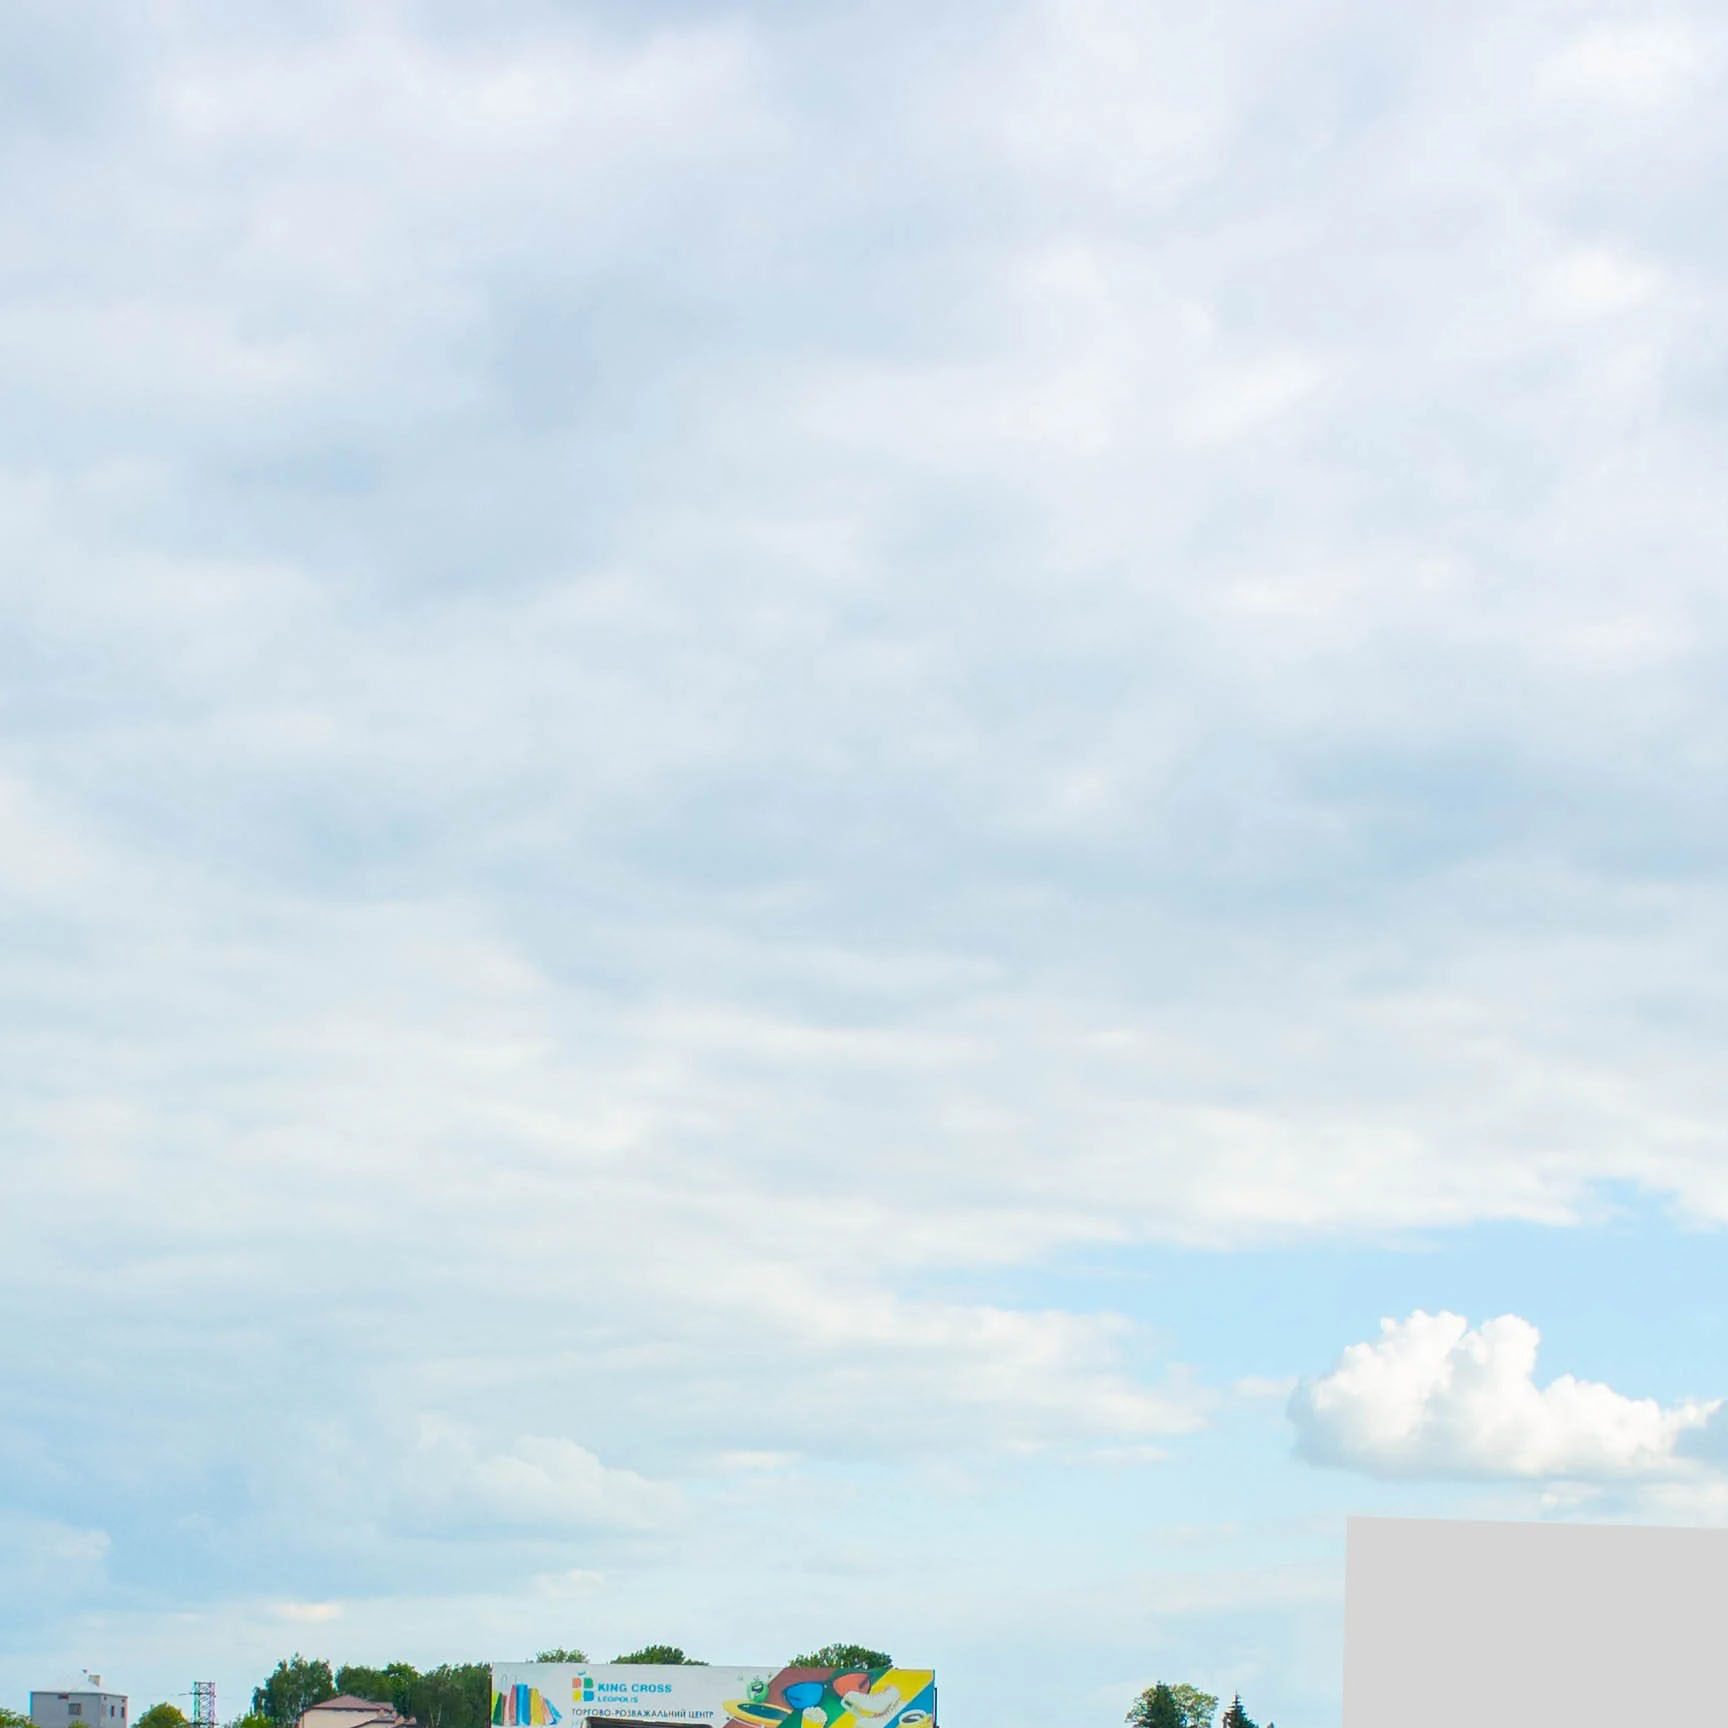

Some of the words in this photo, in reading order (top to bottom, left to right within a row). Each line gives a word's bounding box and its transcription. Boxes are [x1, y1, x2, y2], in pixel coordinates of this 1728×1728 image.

[597, 1682, 628, 1693] KING
[631, 1683, 672, 1694] CROSS
[688, 1710, 714, 1719] ЦЕНТР
